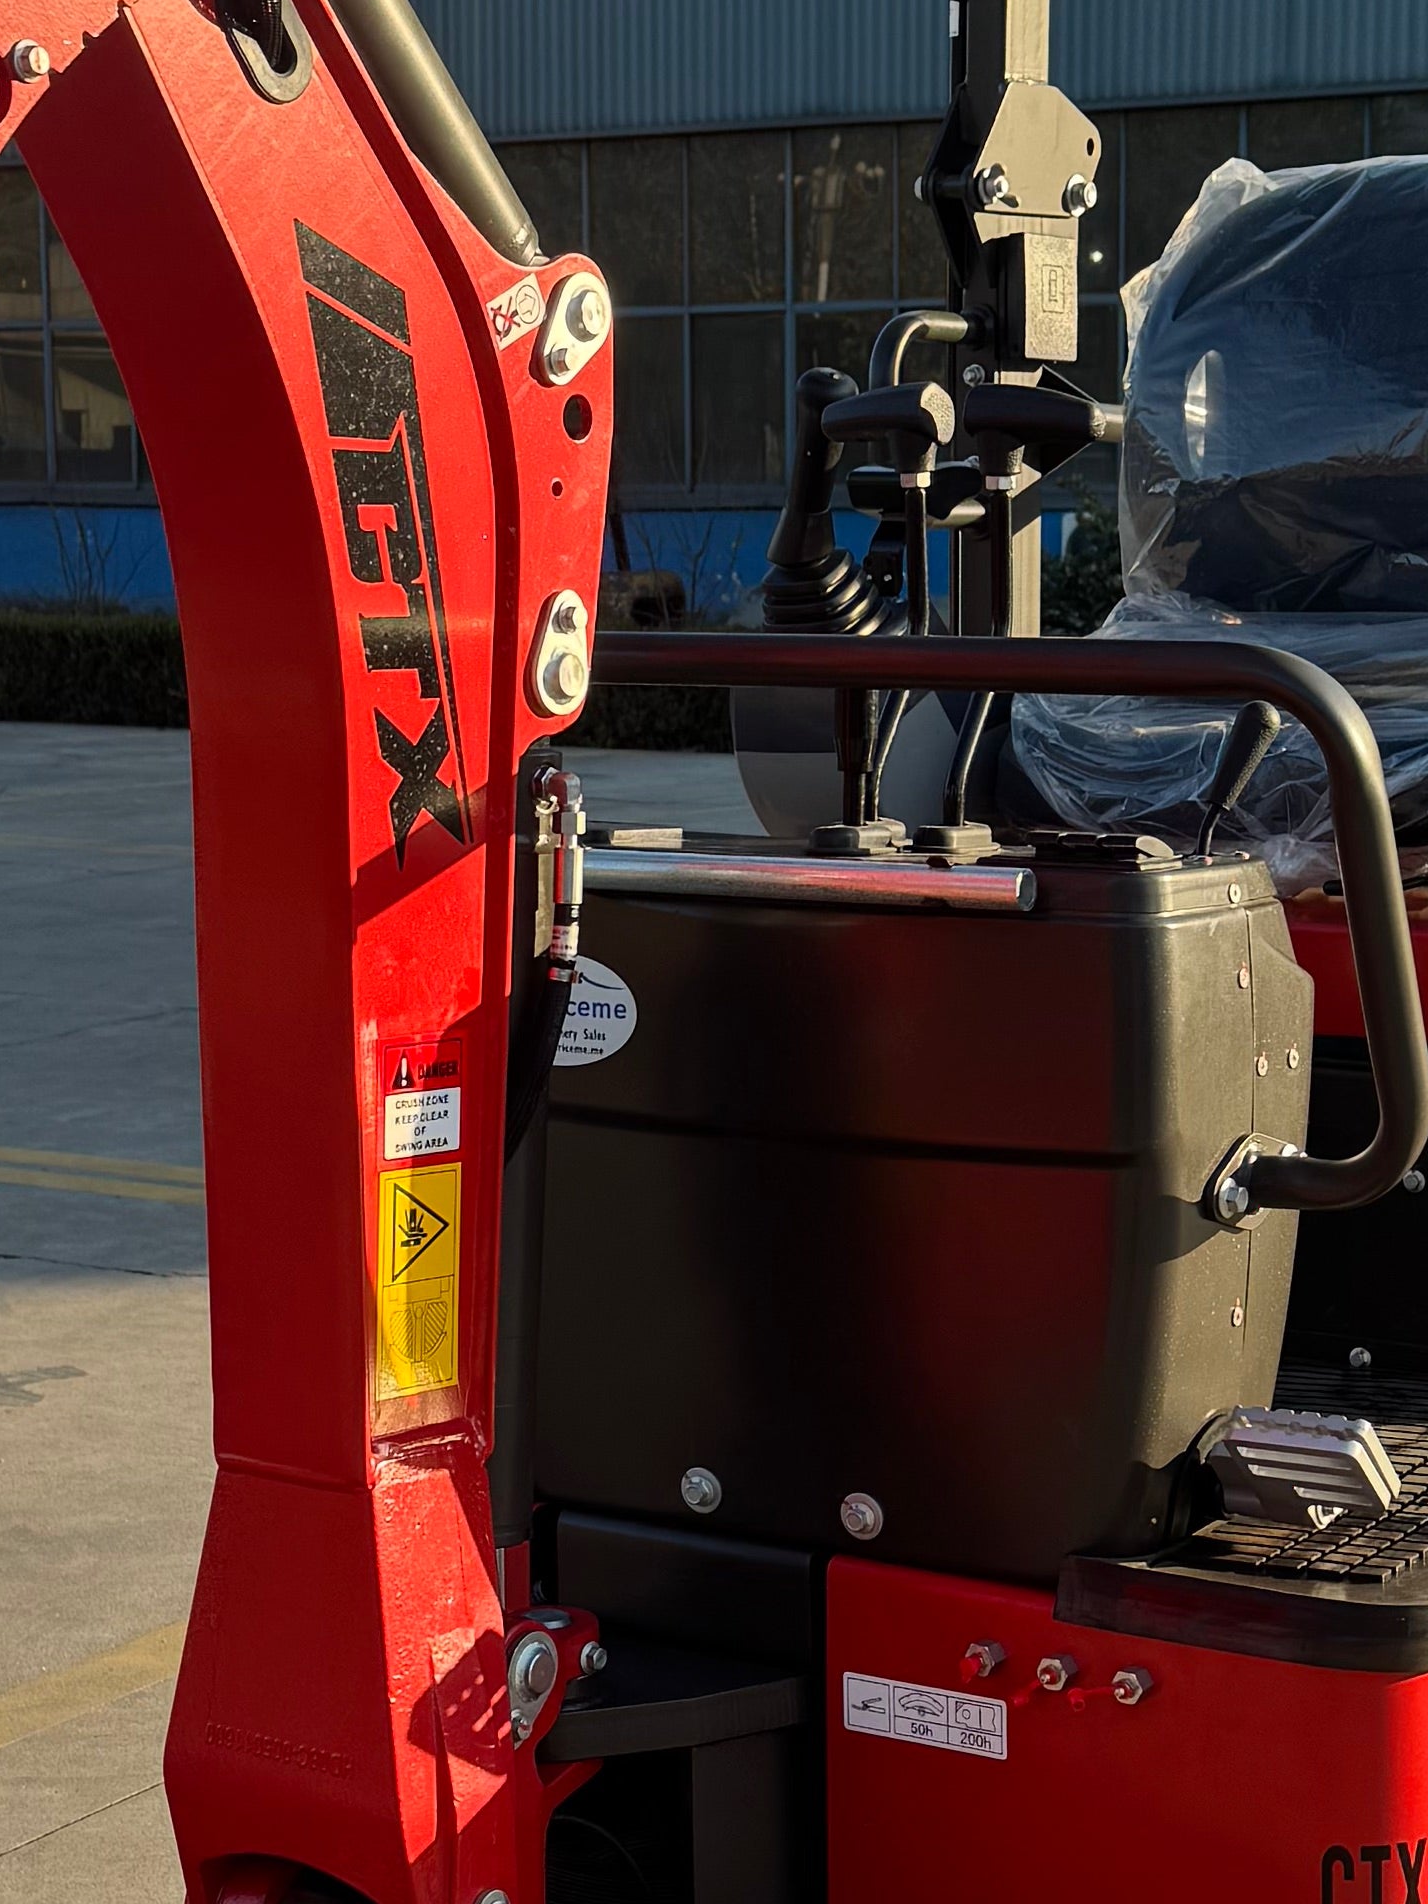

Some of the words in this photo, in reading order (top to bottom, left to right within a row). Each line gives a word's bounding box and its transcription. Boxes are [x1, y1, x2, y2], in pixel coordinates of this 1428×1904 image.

[566, 1000, 627, 1019] ceme
[584, 1029, 606, 1041] Sales
[395, 1096, 425, 1109] CRUSH
[426, 1094, 449, 1106] ZONE
[395, 1114, 418, 1125] KEEP
[420, 1110, 449, 1122] CLEAR
[414, 1126, 426, 1136] OF
[396, 1140, 422, 1152] SWING
[425, 1137, 448, 1149] AREA
[910, 1722, 933, 1737] 50h
[960, 1731, 992, 1750] 200h
